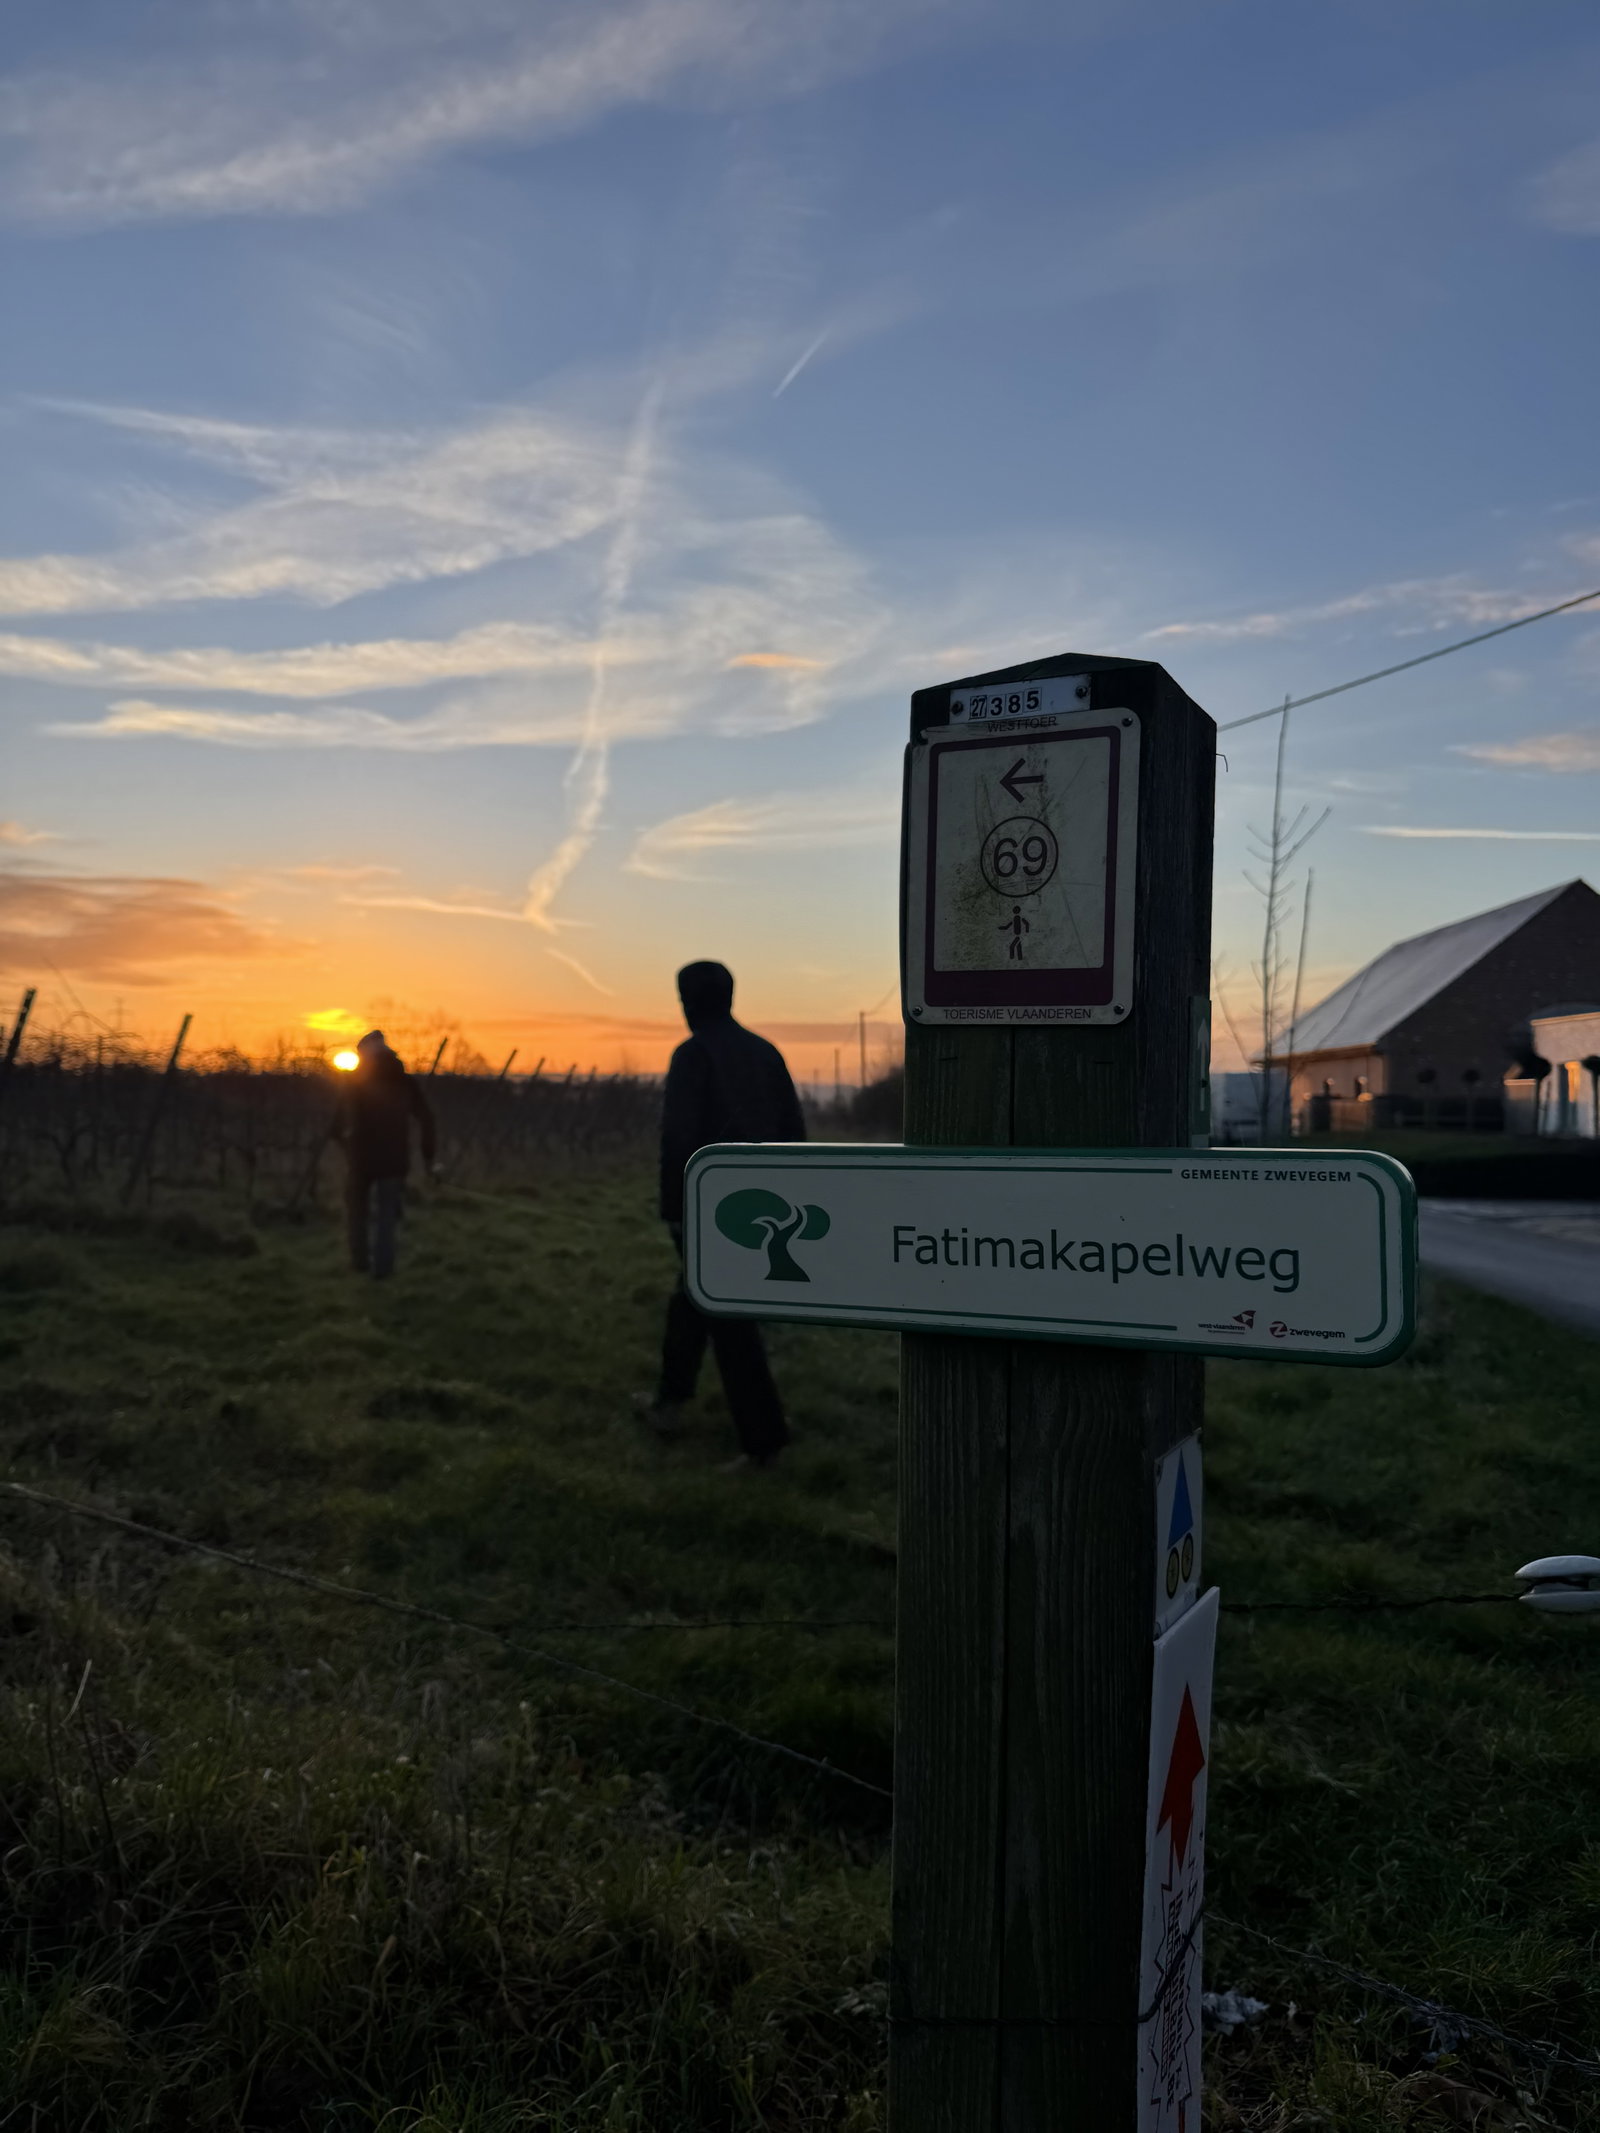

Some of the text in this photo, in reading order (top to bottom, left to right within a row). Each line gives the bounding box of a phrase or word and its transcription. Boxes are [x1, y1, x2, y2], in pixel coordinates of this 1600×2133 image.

[987, 716, 1057, 732] WESTTOER
[993, 835, 1048, 878] 69
[943, 1007, 1092, 1020] TOERISME VLAANDEREN
[1180, 1168, 1352, 1183] GEMEENTE ZWEVEGEM
[892, 1225, 1301, 1293] Fatimakapelweg
[1289, 1326, 1346, 1340] zwevegem
